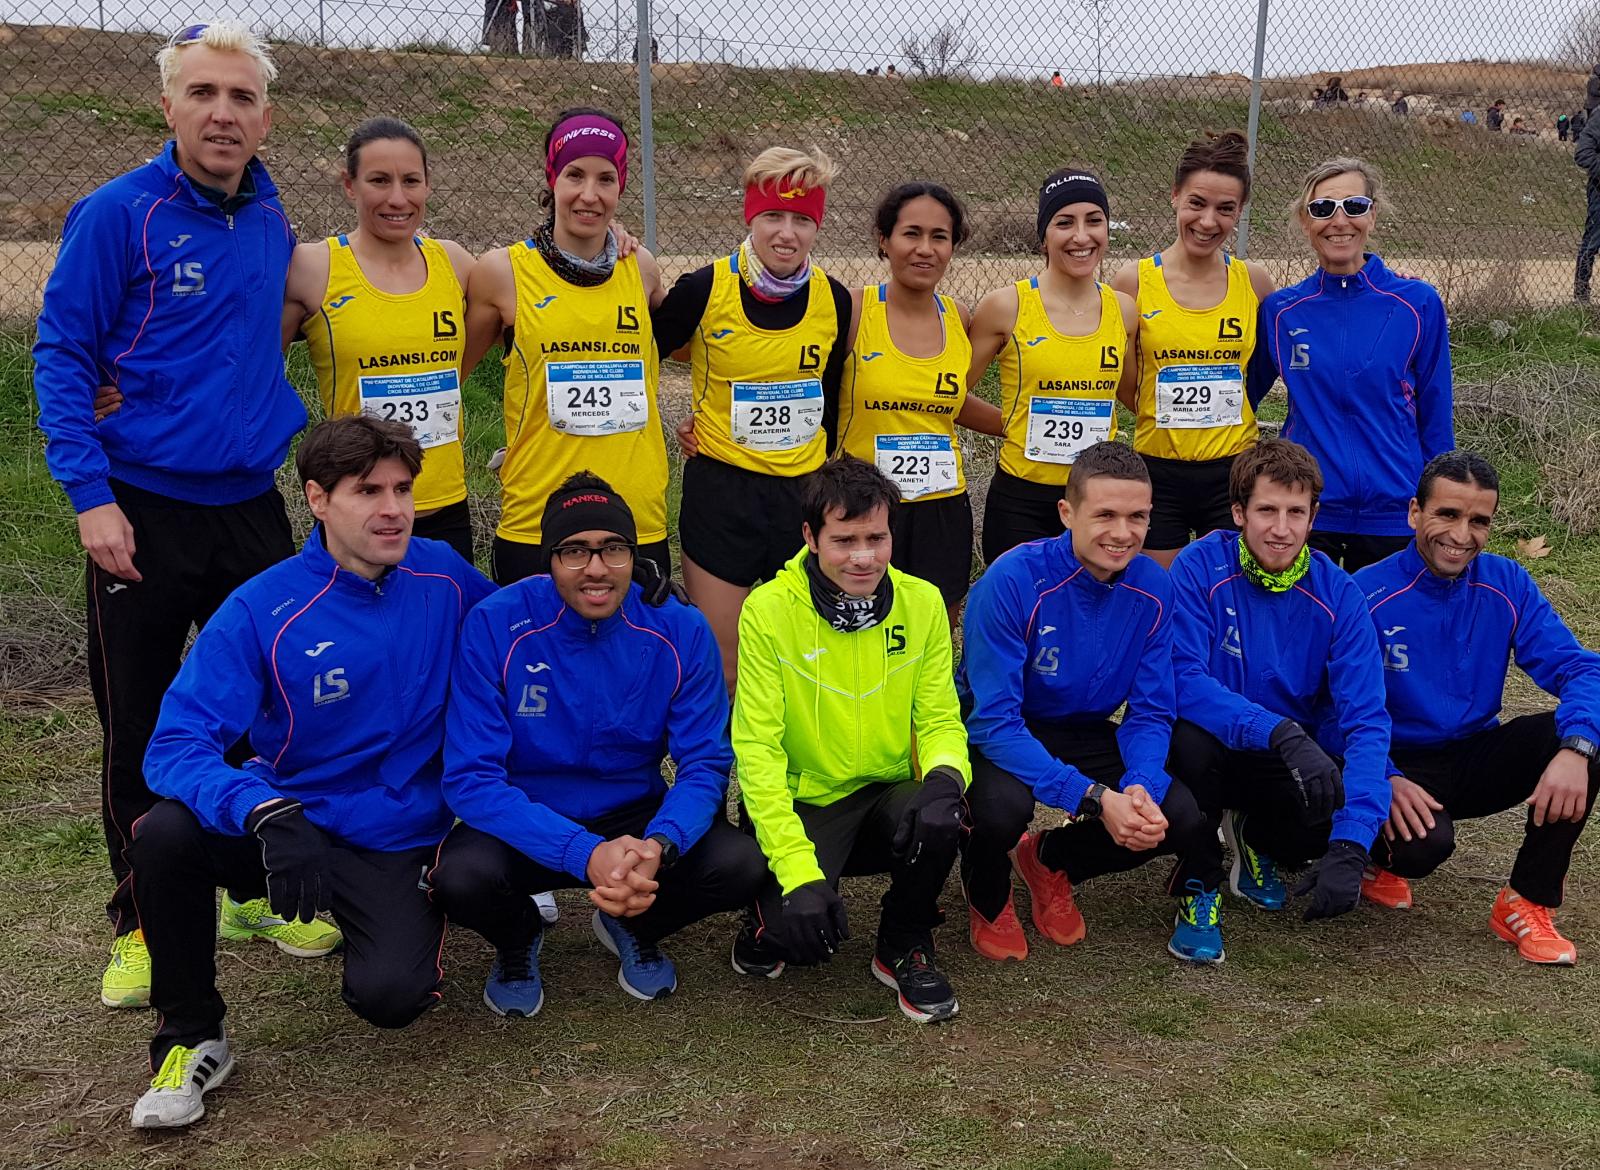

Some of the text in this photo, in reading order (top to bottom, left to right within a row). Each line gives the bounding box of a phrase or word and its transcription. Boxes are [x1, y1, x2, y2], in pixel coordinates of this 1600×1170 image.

[563, 127, 616, 144] INVERSE
[173, 262, 205, 292] LS
[433, 311, 457, 338] LS
[617, 305, 639, 330] LS
[1218, 317, 1242, 338] LS
[540, 341, 640, 354] LASANSI.COM
[798, 345, 820, 370] LS
[1100, 346, 1119, 368] LS
[1154, 349, 1241, 360] LASANSI.COM
[1289, 343, 1310, 367] LS
[358, 350, 457, 369] LASANSI.COM
[935, 372, 959, 396] LS
[567, 386, 612, 408] 243
[1172, 386, 1211, 405] 229
[382, 400, 429, 422] 233
[749, 406, 791, 427] 238
[864, 400, 954, 415] LASANSI.COM
[750, 427, 791, 435] JEKATERINA
[1043, 419, 1084, 440] 239
[891, 455, 930, 475] 223
[1384, 644, 1409, 669] LS
[314, 667, 350, 704] LS
[517, 684, 548, 713] LS
